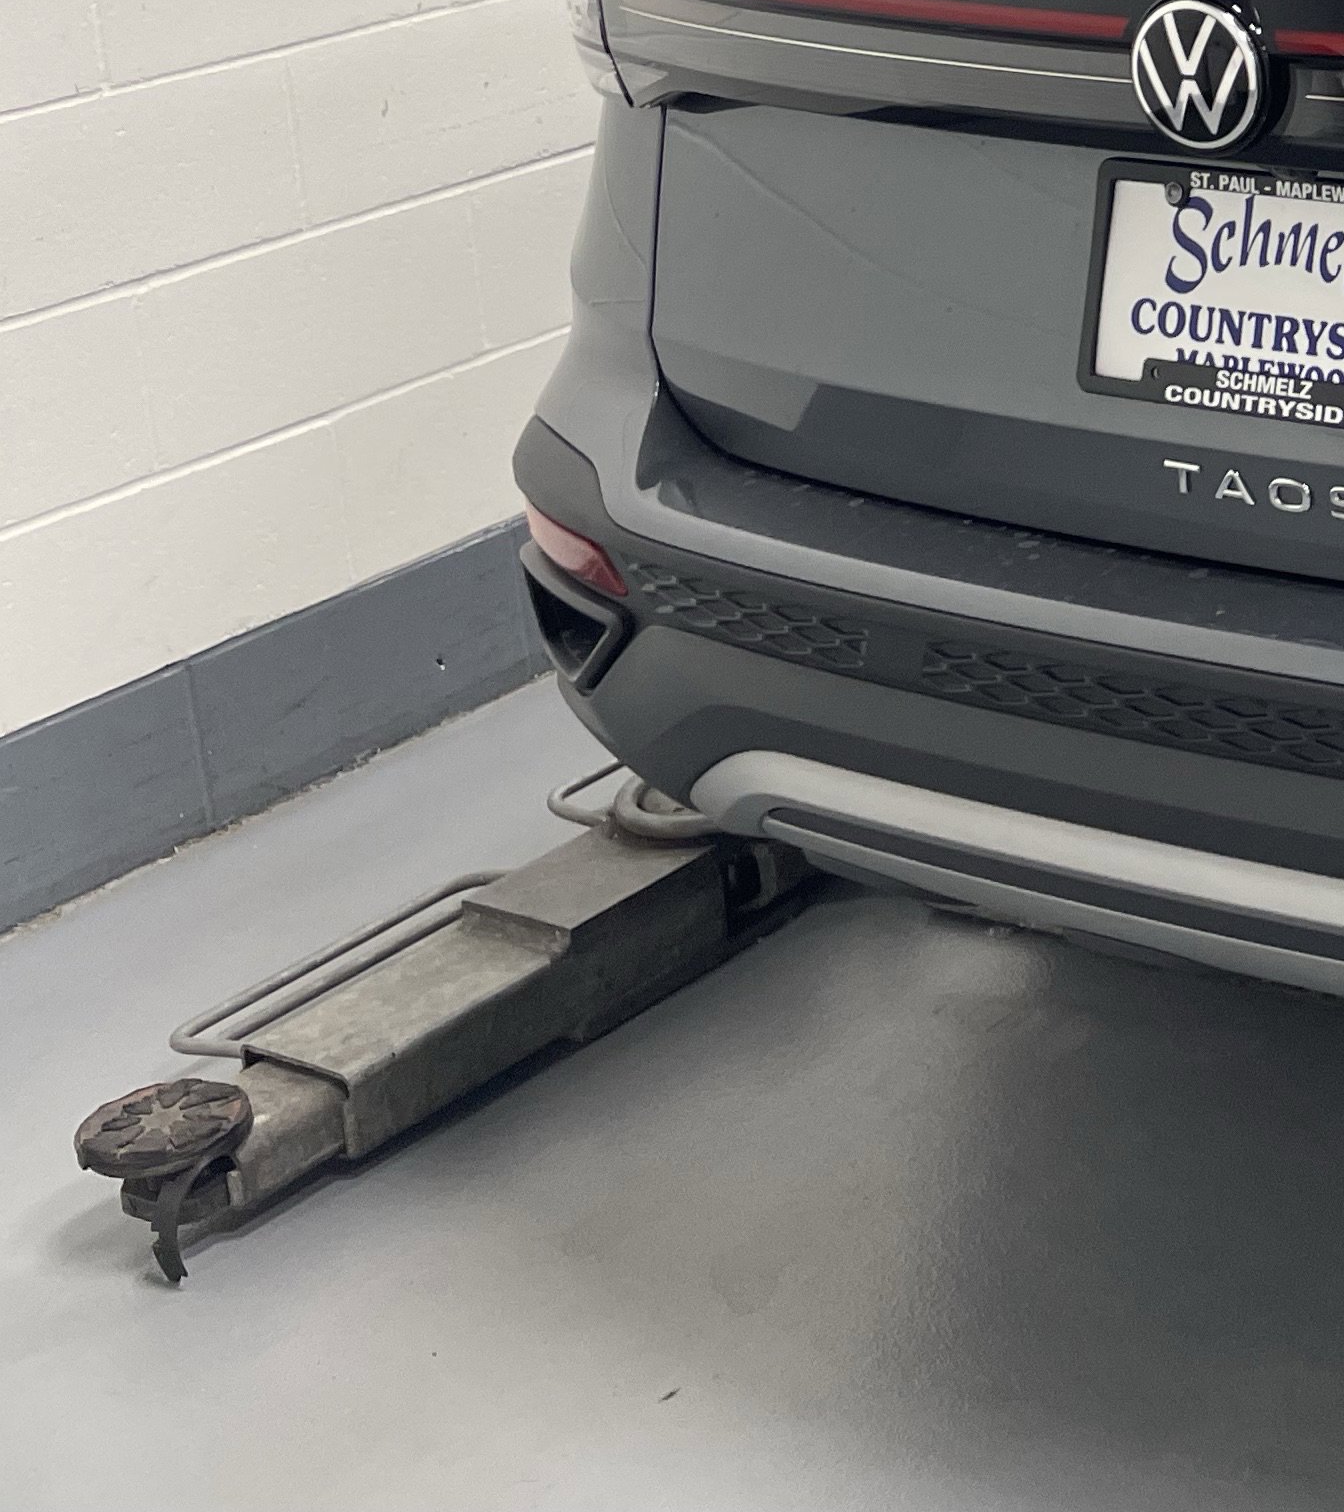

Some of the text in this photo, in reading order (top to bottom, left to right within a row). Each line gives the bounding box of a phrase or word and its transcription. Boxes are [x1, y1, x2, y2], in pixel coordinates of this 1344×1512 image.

[1189, 170, 1215, 190] ST.
[1218, 174, 1261, 196] PAUL
[1215, 369, 1314, 400] SCHMELZ
